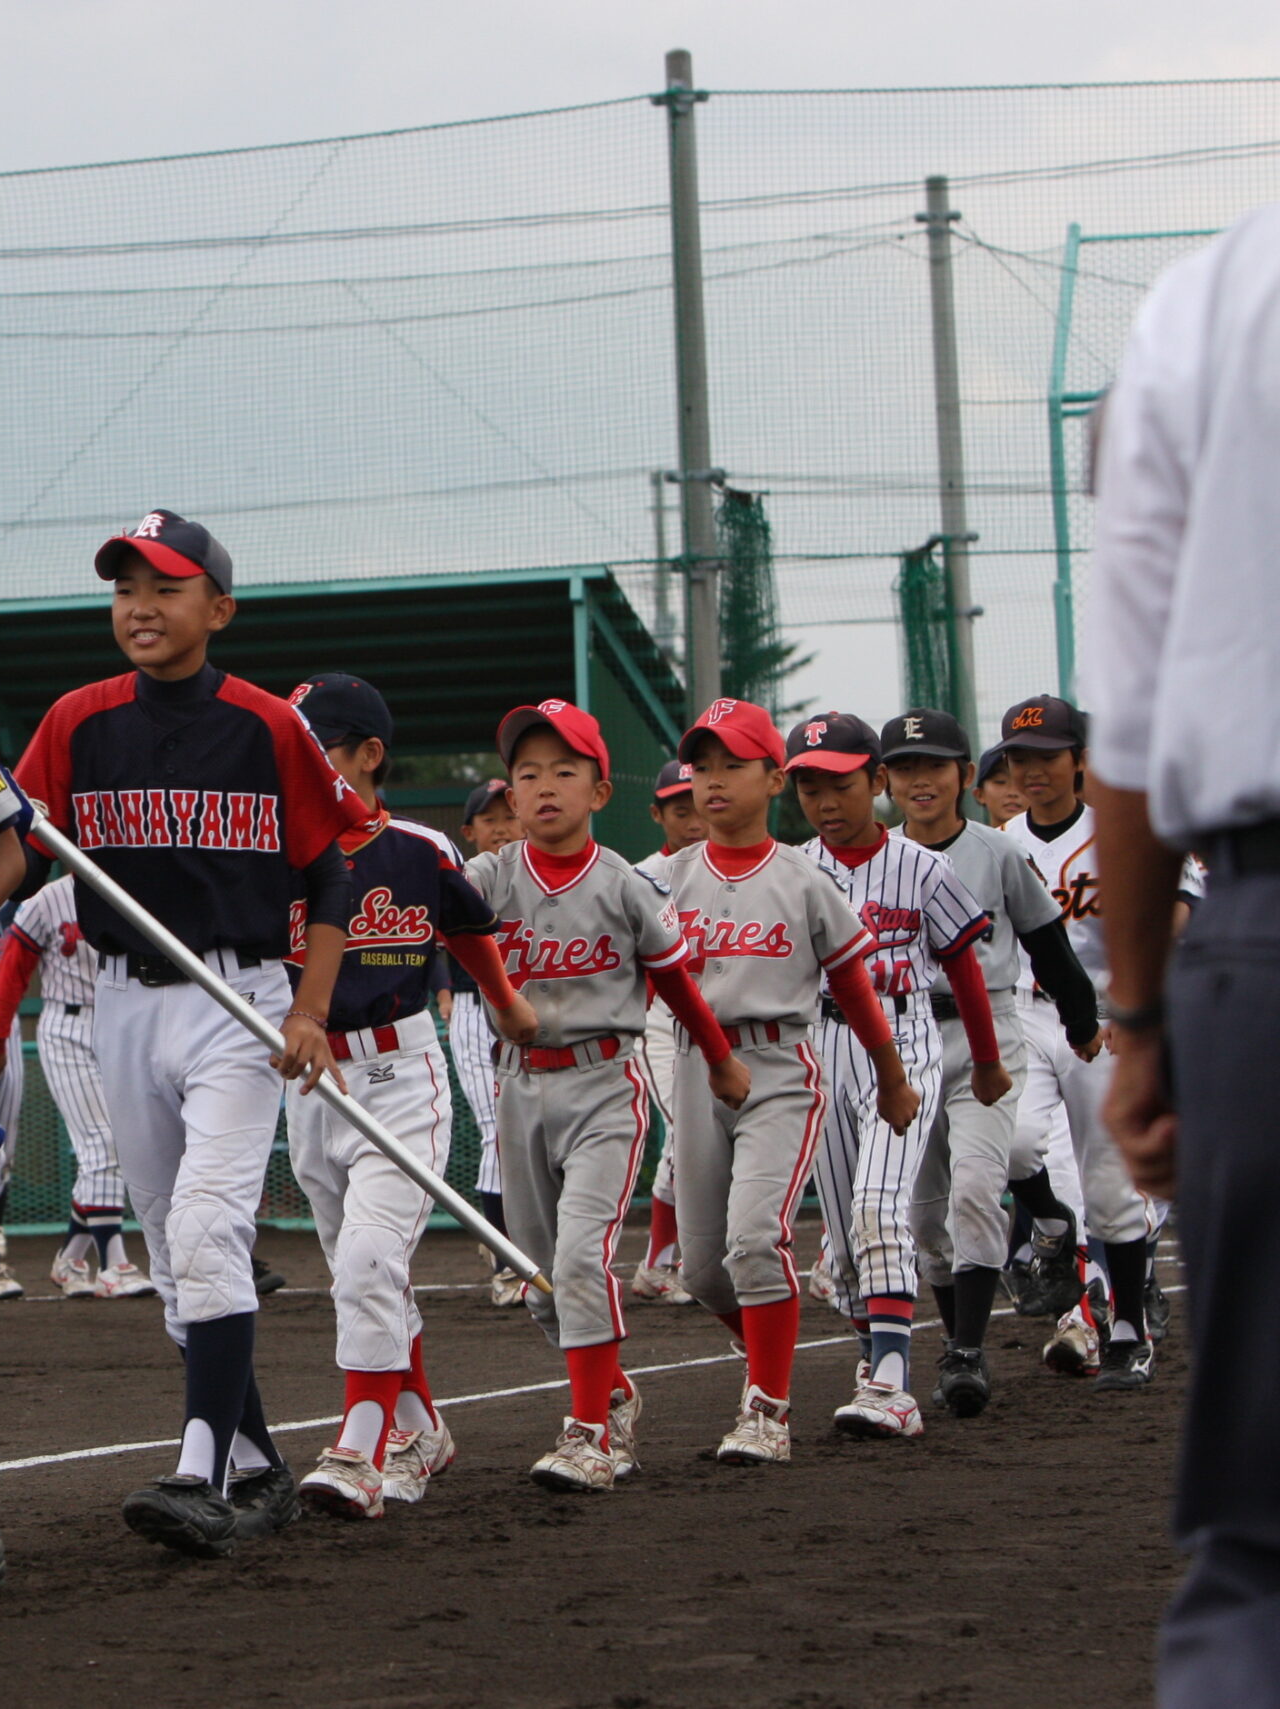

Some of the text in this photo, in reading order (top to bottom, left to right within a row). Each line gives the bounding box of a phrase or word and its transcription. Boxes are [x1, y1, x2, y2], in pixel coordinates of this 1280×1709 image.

[903, 716, 925, 740] E
[1011, 706, 1046, 730] M
[804, 721, 828, 747] T
[72, 788, 281, 853] KANAYAMA
[348, 886, 433, 941] Sox
[360, 952, 404, 966] BASEBALL
